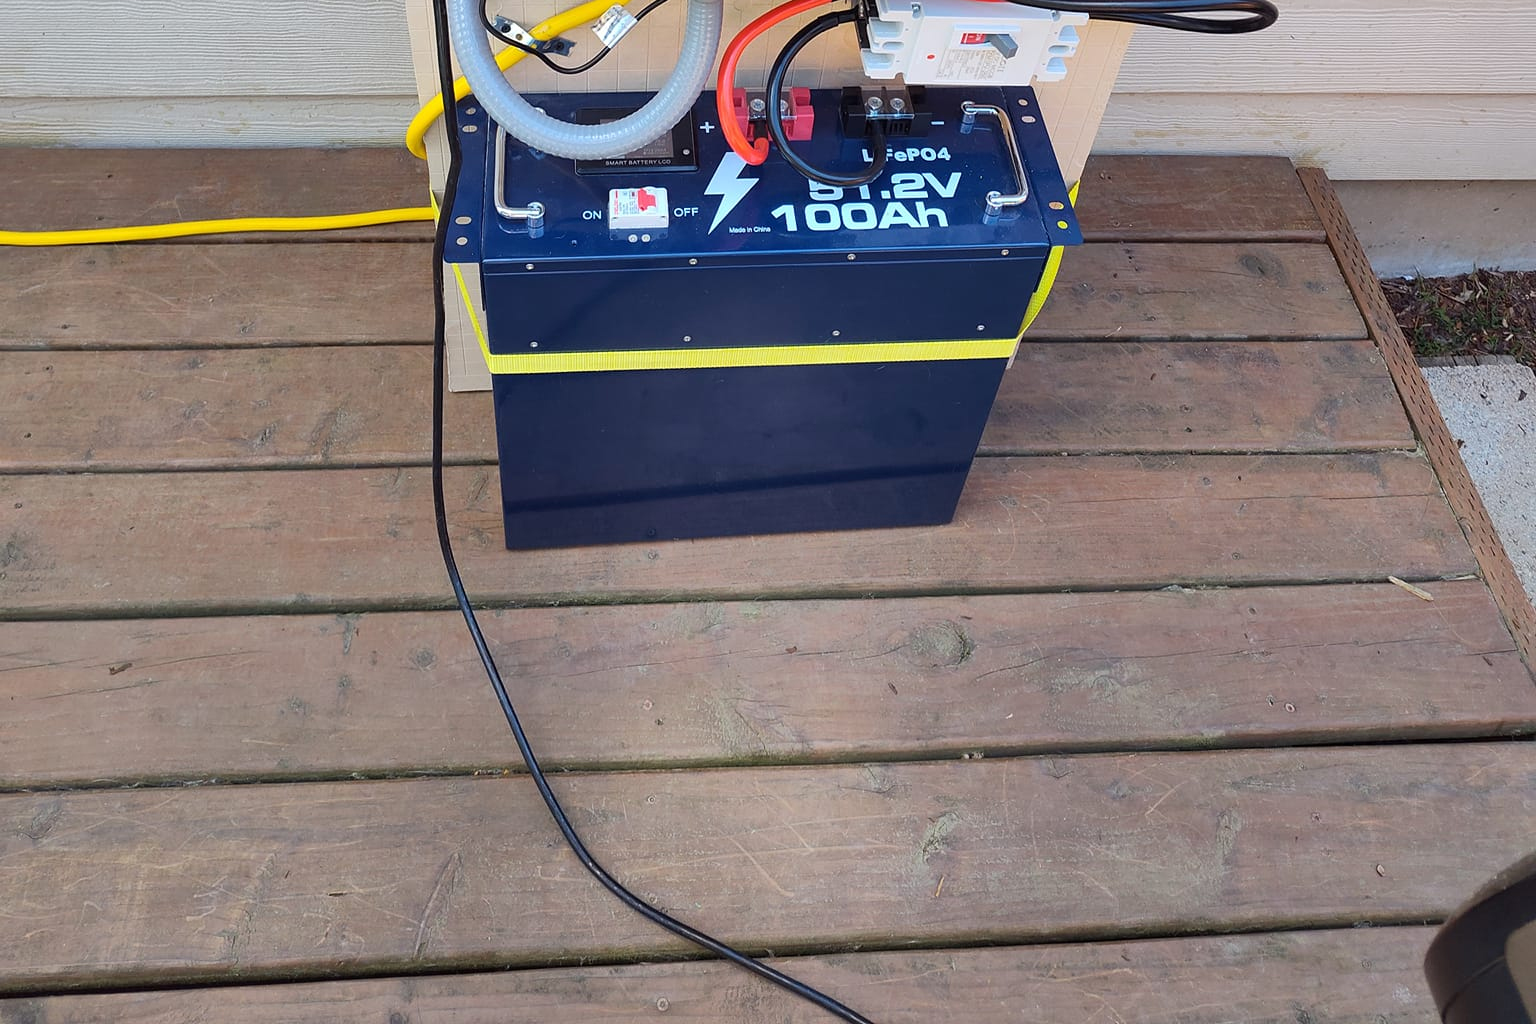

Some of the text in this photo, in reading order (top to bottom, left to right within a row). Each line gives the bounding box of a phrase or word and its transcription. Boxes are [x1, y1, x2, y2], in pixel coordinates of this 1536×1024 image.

[582, 210, 602, 220] ON
[673, 207, 699, 218] OFF
[771, 201, 949, 232] 100Ah
